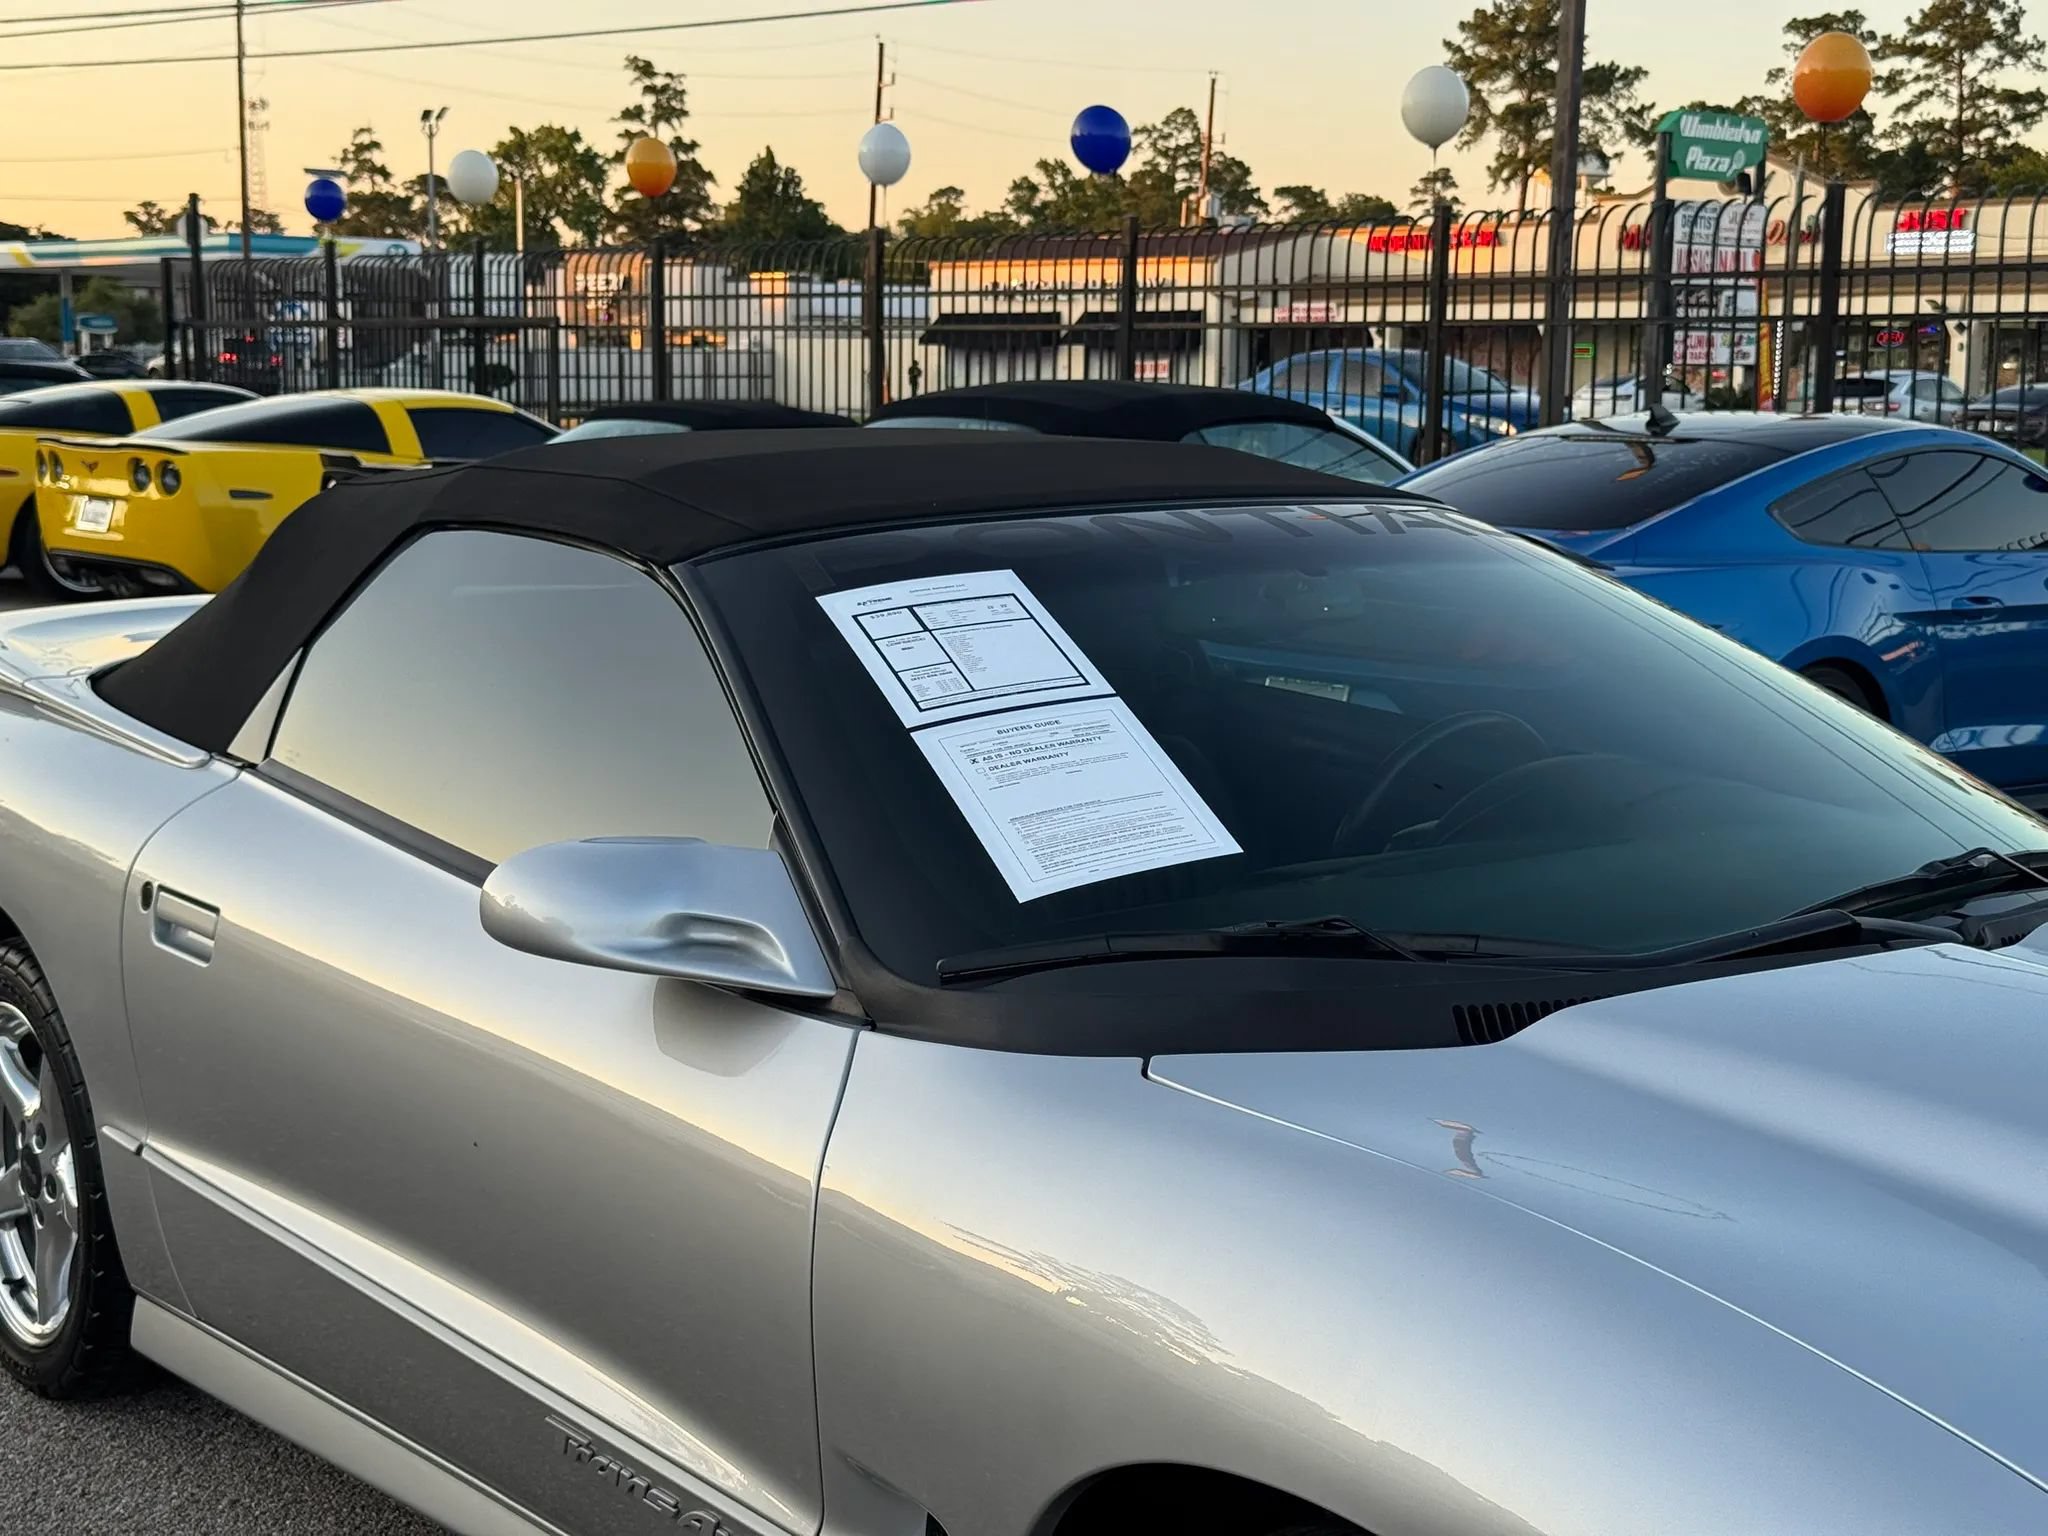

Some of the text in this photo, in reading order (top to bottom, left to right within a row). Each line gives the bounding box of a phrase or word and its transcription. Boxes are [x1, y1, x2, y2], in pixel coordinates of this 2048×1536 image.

[1680, 114, 1764, 144] Wimbledon
[1685, 145, 1731, 173] Plaza
[1897, 208, 1968, 232] JUST
[997, 719, 1063, 735] BUYERS GUIDE
[1023, 743, 1056, 753] DEALER
[1056, 735, 1102, 748] WARRANTY
[988, 751, 1070, 772] DEALER WARRANTY
[544, 1414, 735, 1536] Trans A
